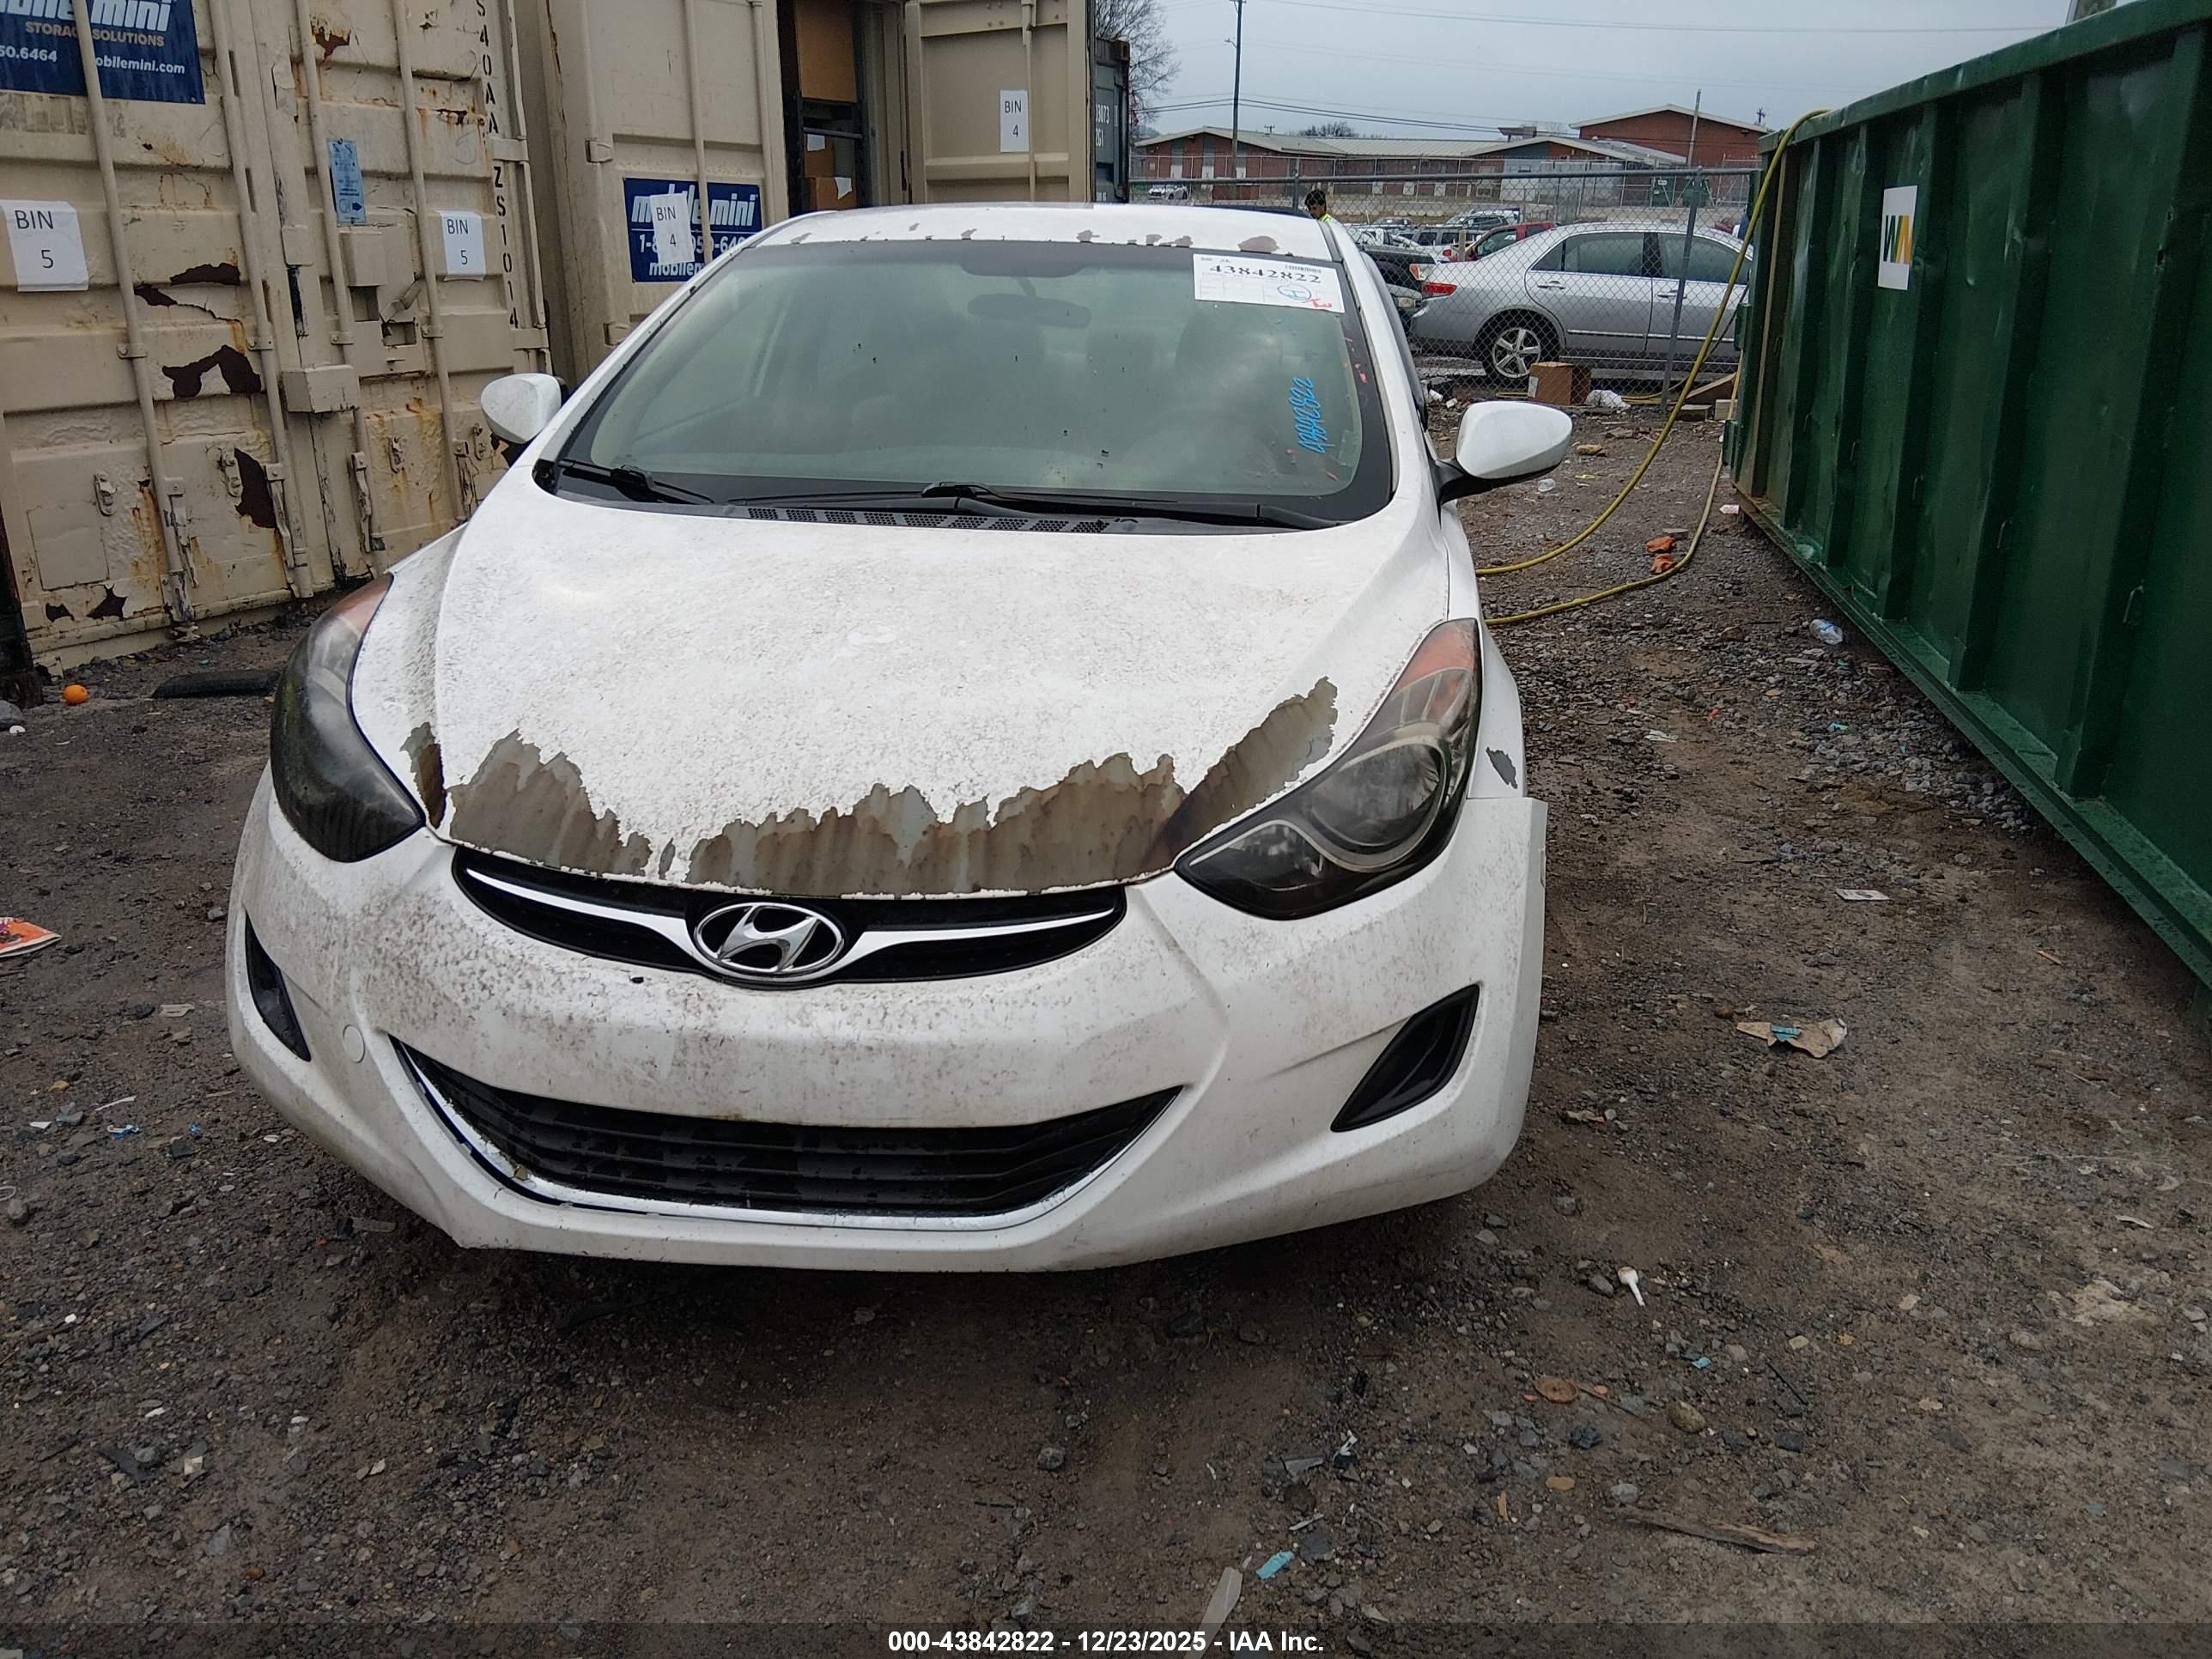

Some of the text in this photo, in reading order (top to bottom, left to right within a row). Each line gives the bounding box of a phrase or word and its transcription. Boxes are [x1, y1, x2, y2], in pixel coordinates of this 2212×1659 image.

[90, 0, 172, 32] mini
[93, 28, 165, 47] SOLUTIONS
[95, 55, 185, 75] obilemini.com
[1005, 100, 1022, 113] BIN
[1012, 125, 1019, 137] 4
[656, 206, 677, 221] BIN
[710, 193, 757, 226] mini
[15, 210, 54, 229] BIN
[447, 218, 469, 234] BIN
[669, 233, 677, 247] 4
[40, 249, 54, 269] 5
[460, 249, 468, 265] 5
[1209, 264, 1322, 283] 43842822
